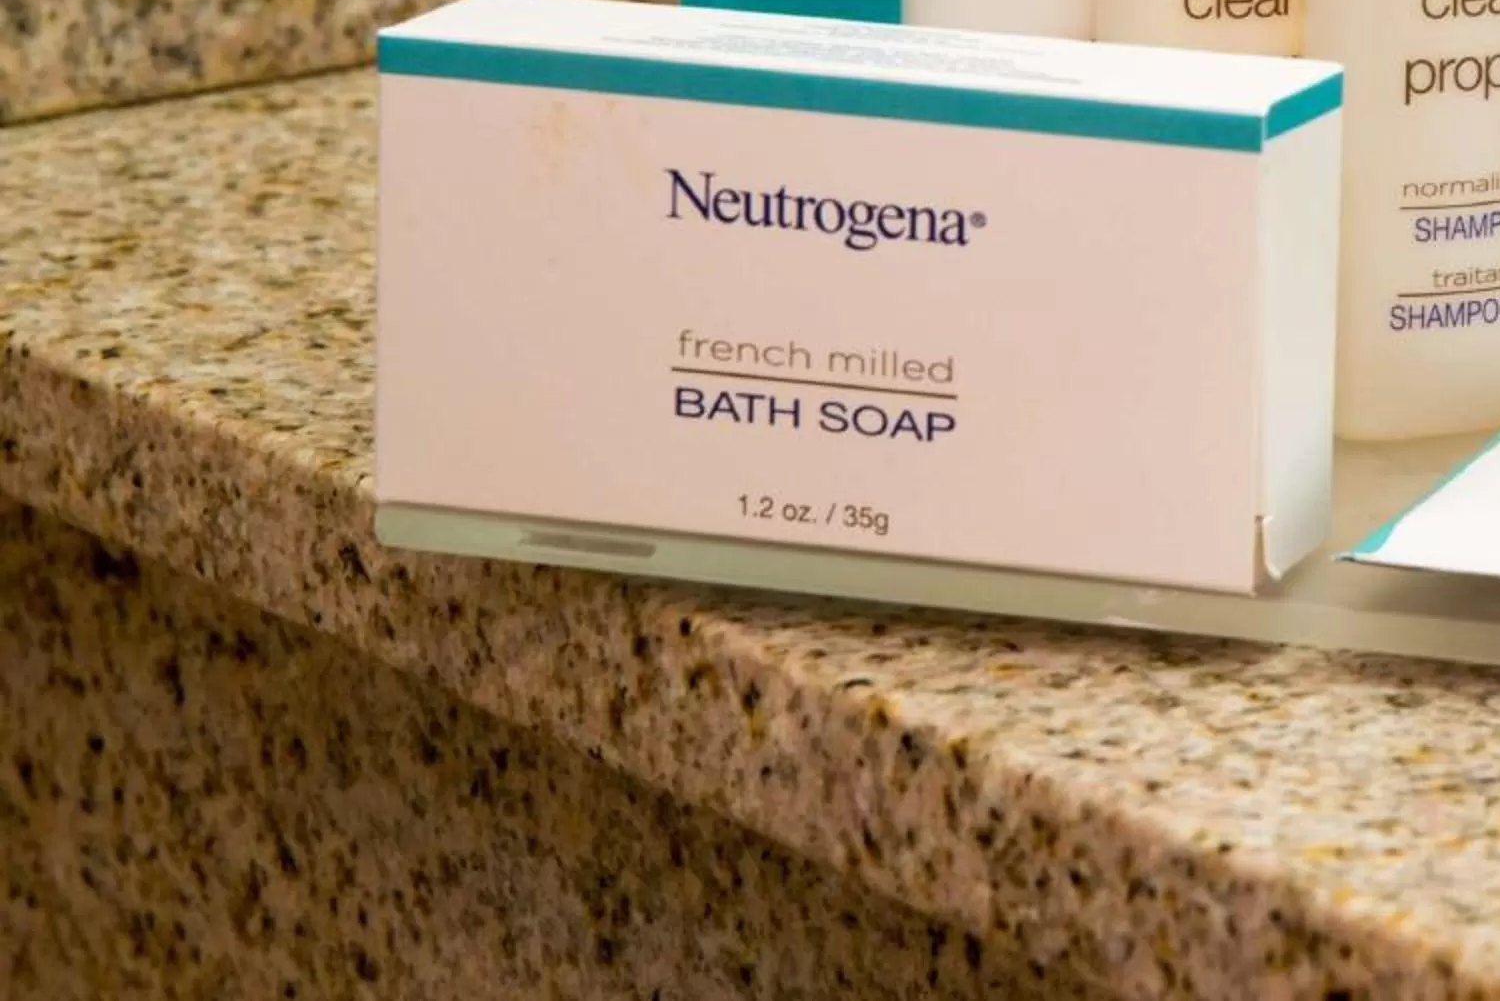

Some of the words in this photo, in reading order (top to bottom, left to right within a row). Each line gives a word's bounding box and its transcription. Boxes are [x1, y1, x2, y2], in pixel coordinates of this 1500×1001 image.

[678, 330, 811, 369] french
[828, 349, 954, 383] milled
[674, 388, 801, 428] BATH
[819, 402, 955, 442] SOAP
[738, 494, 774, 520] 1.2
[783, 501, 817, 524] oz.
[843, 505, 889, 535] 35g
